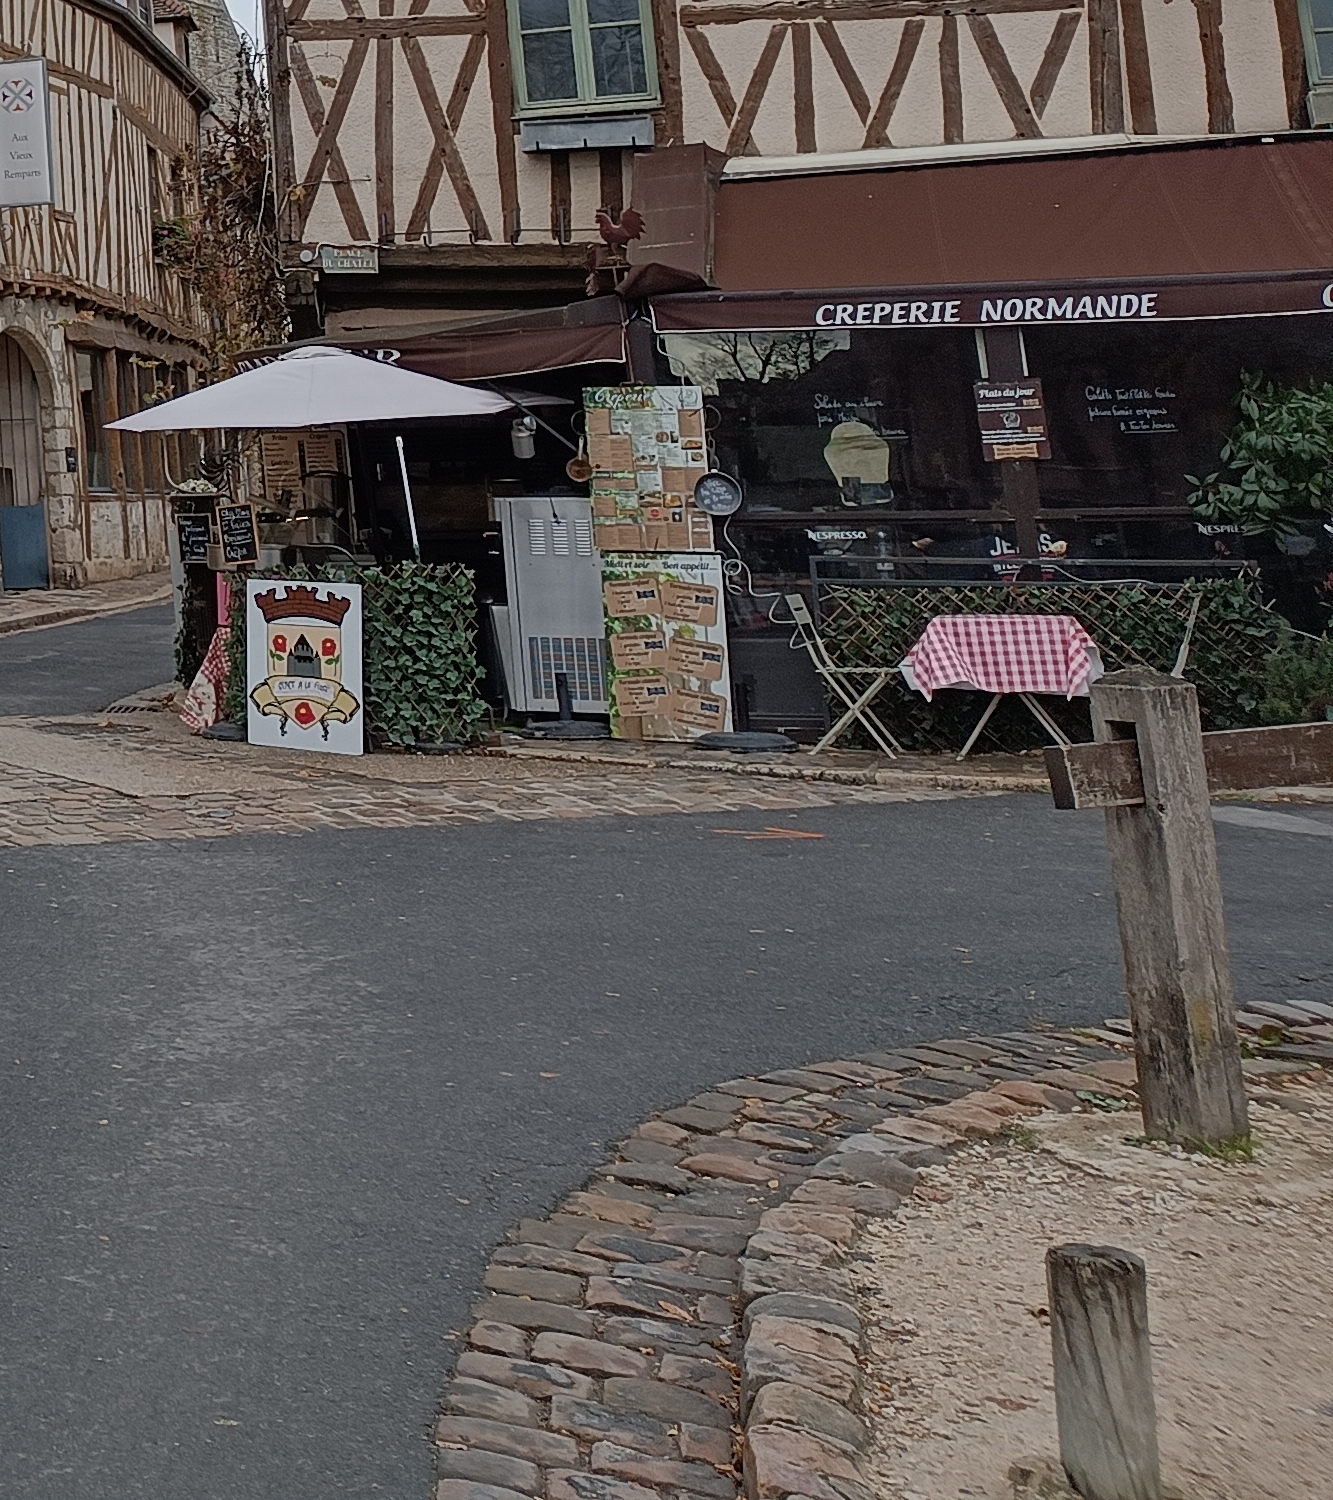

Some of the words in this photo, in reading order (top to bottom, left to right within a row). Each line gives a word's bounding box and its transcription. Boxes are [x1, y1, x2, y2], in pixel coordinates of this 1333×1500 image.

[11, 133, 29, 143] Aux
[9, 151, 34, 160] Vieux
[3, 169, 42, 180] Remparts
[815, 301, 961, 326] CREPERIE
[980, 293, 1159, 322] NORMANDE
[1003, 388, 1015, 397] du
[1193, 522, 1246, 536] NESPRES
[804, 529, 868, 542] NESPRESSO
[662, 562, 679, 570] Bon
